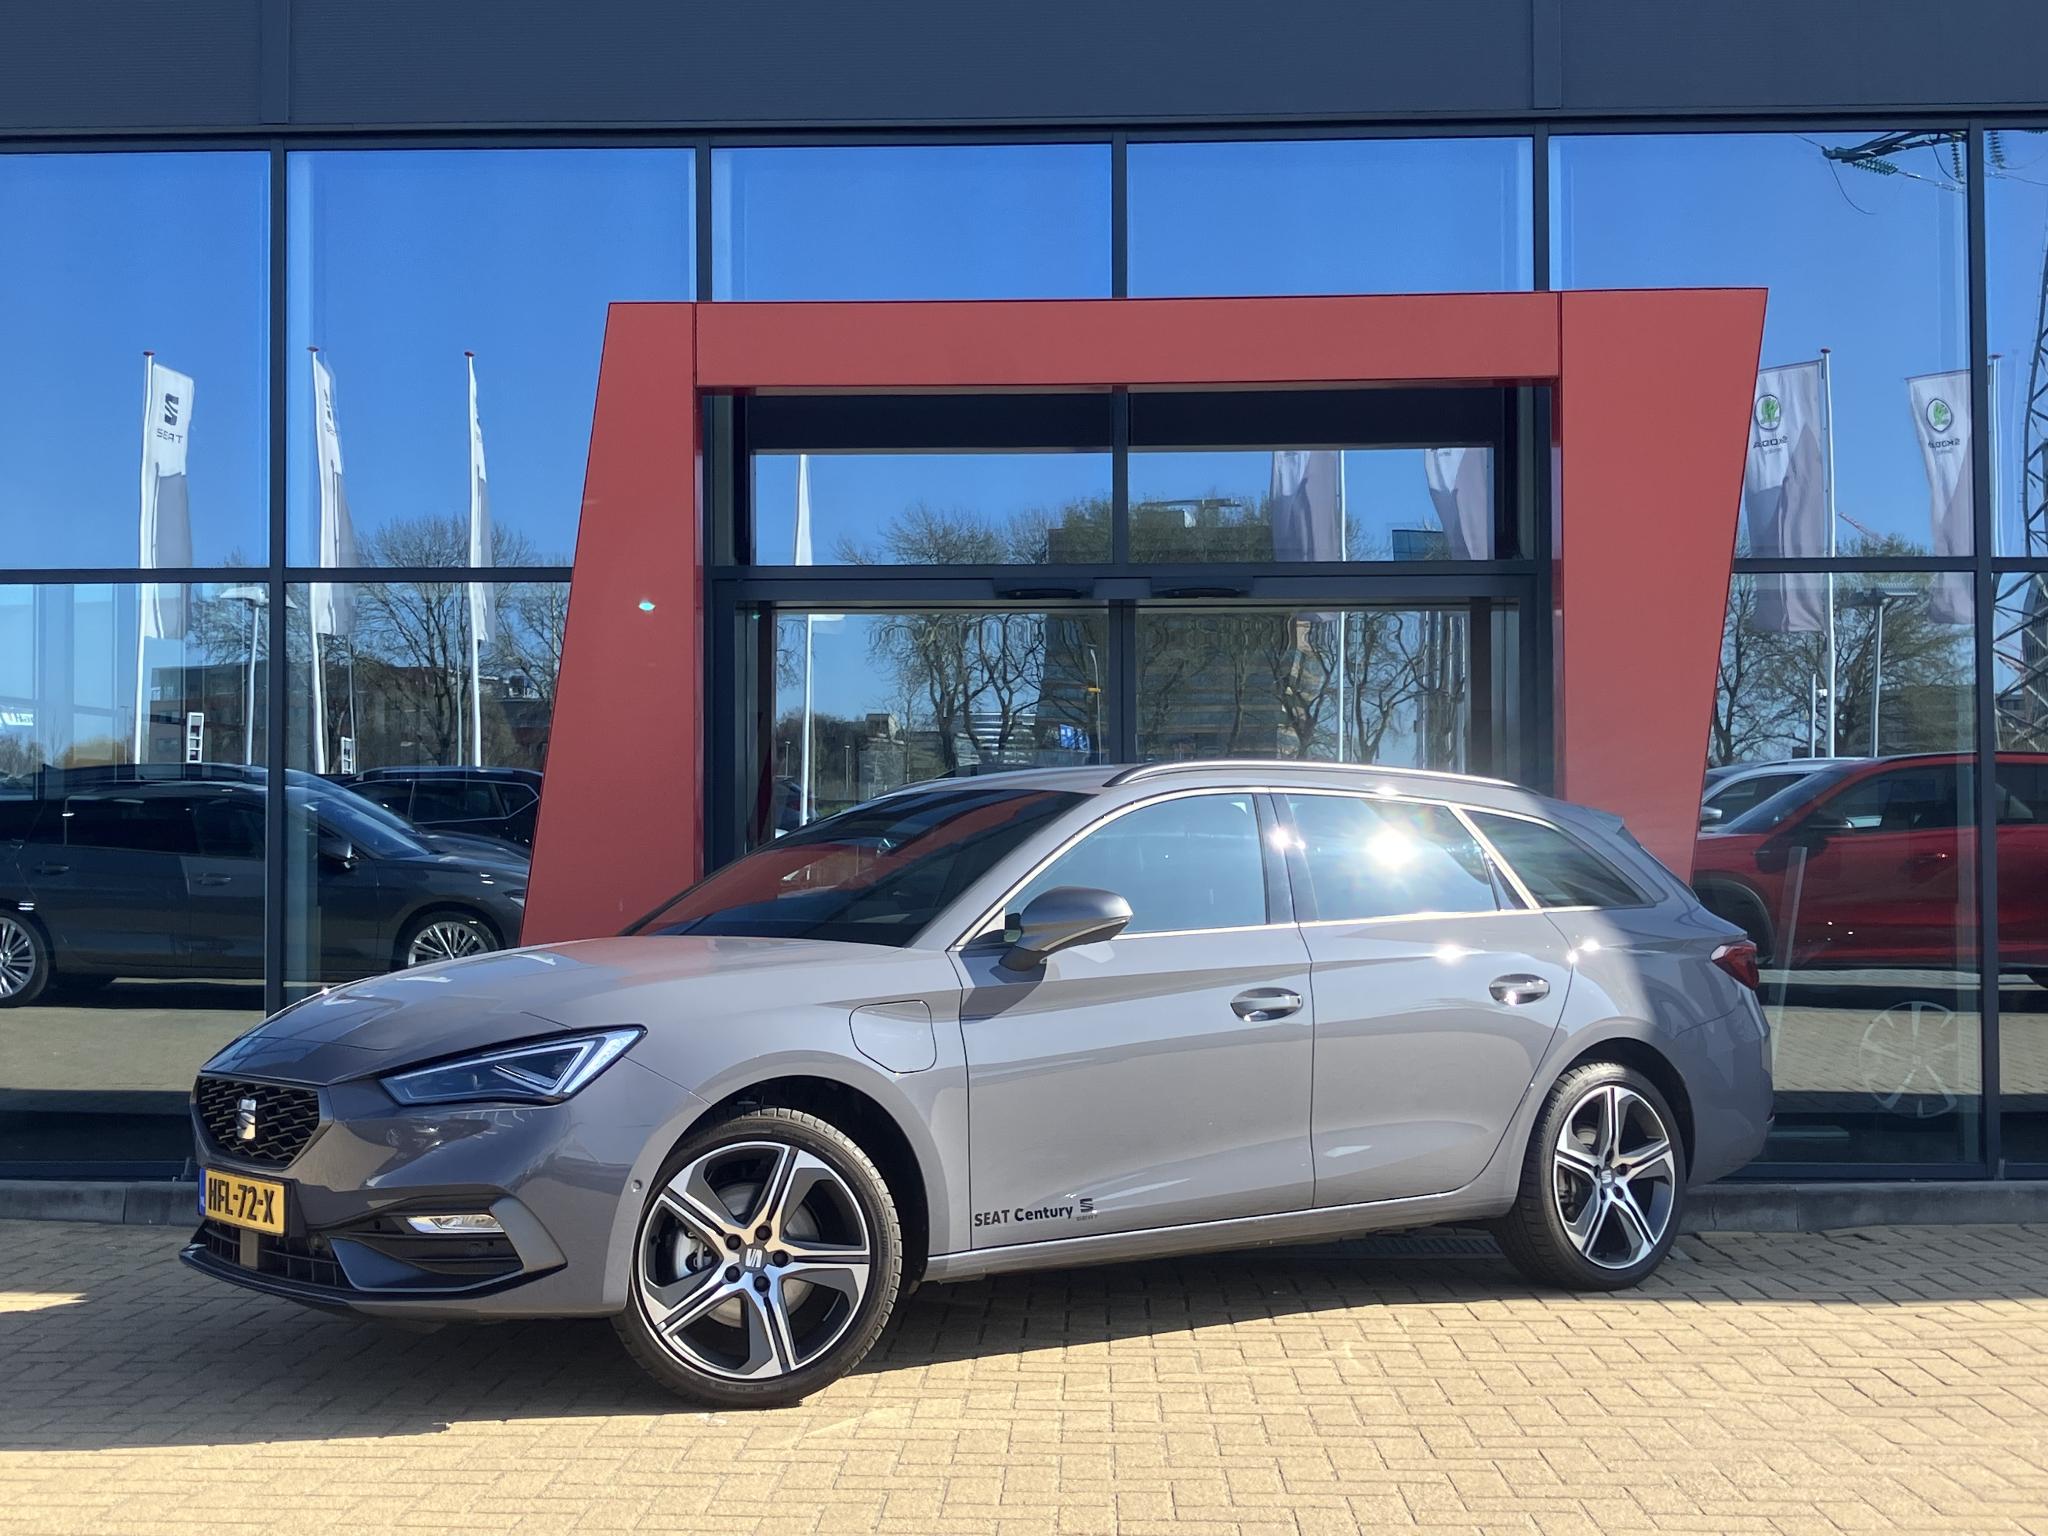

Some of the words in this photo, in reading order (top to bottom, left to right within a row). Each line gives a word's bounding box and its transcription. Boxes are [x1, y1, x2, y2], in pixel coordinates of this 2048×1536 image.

[156, 427, 184, 444] SEAT
[208, 1177, 275, 1225] HFL-72-X
[974, 1208, 1010, 1227] SEAT
[1014, 1205, 1073, 1222] Century
